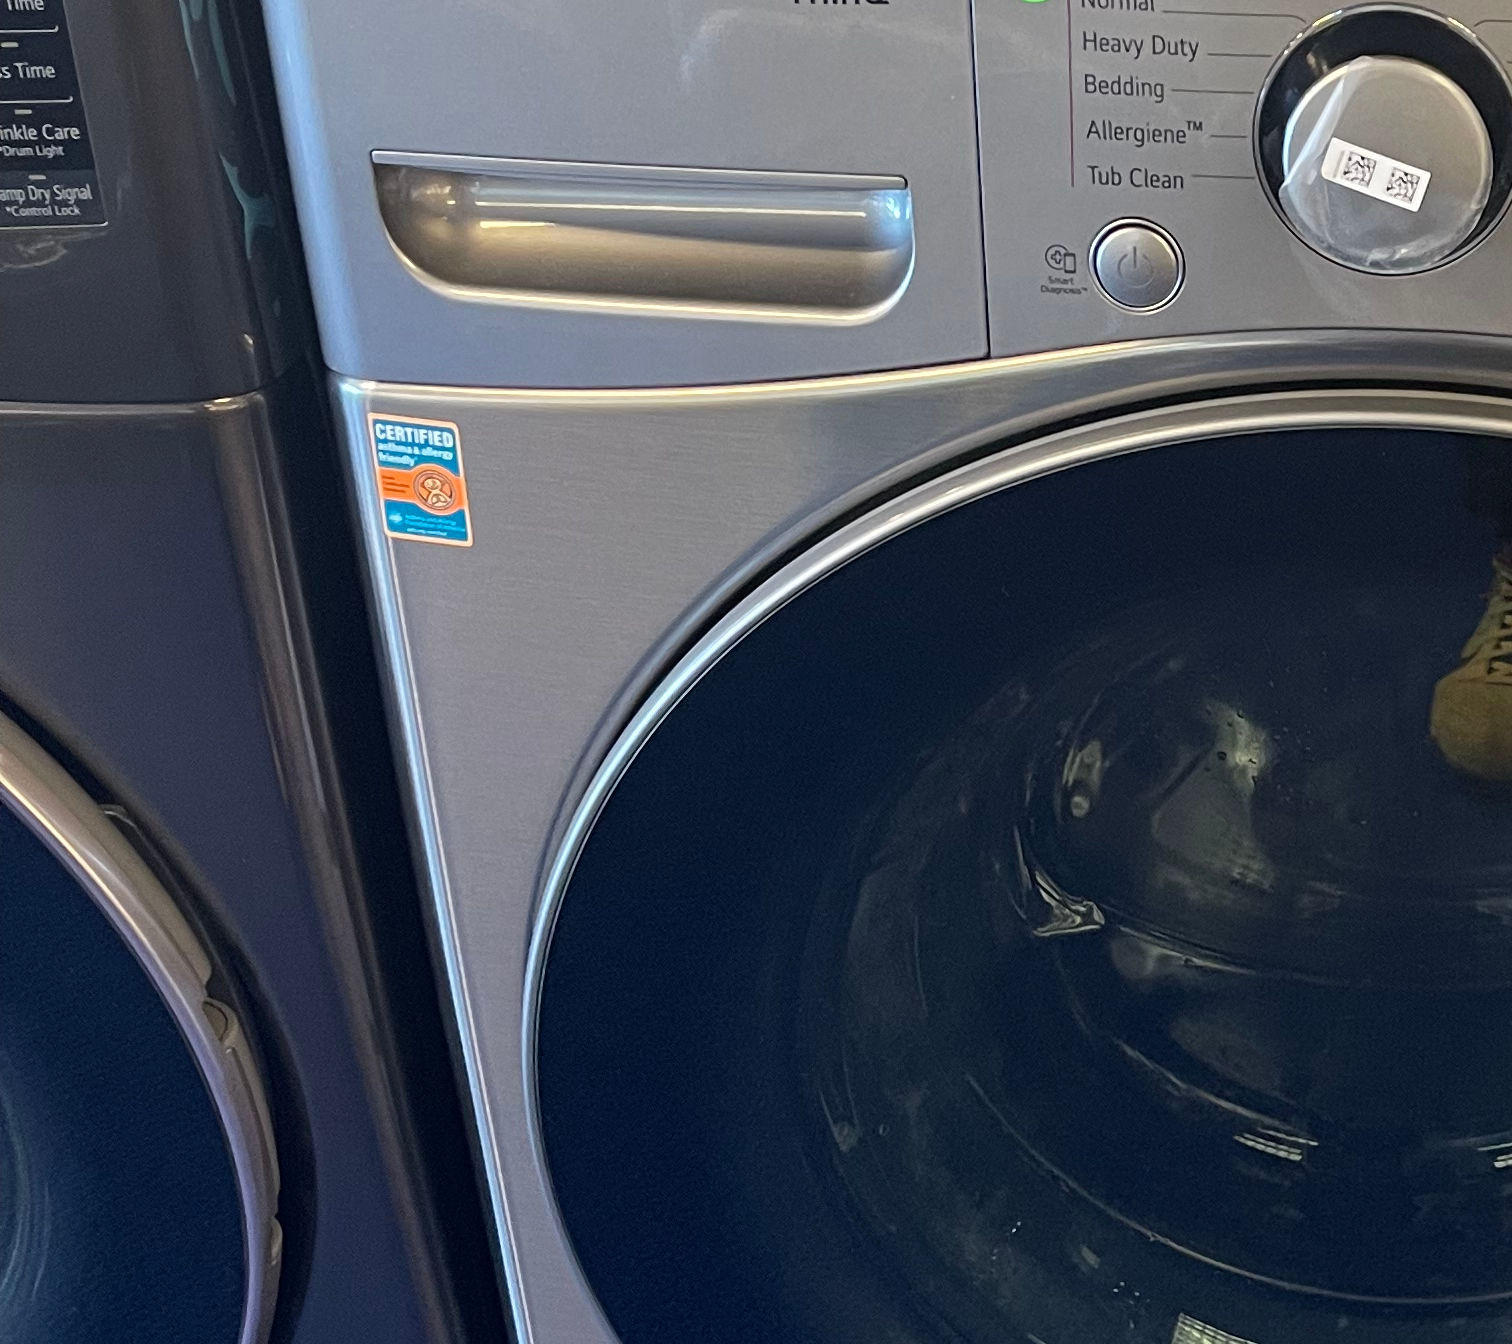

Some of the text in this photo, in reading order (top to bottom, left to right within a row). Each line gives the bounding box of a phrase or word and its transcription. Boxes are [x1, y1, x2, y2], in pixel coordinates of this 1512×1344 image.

[1082, 31, 1200, 63] Heavy Duty
[13, 61, 56, 79] Time
[1084, 73, 1165, 103] Bedding
[41, 123, 81, 140] Care
[35, 144, 65, 159] Light
[1086, 164, 1185, 190] Tub Clean
[27, 185, 51, 205] Dry
[52, 183, 94, 205] Signal
[54, 205, 81, 216] Lock
[375, 422, 454, 448] CERTIFIED
